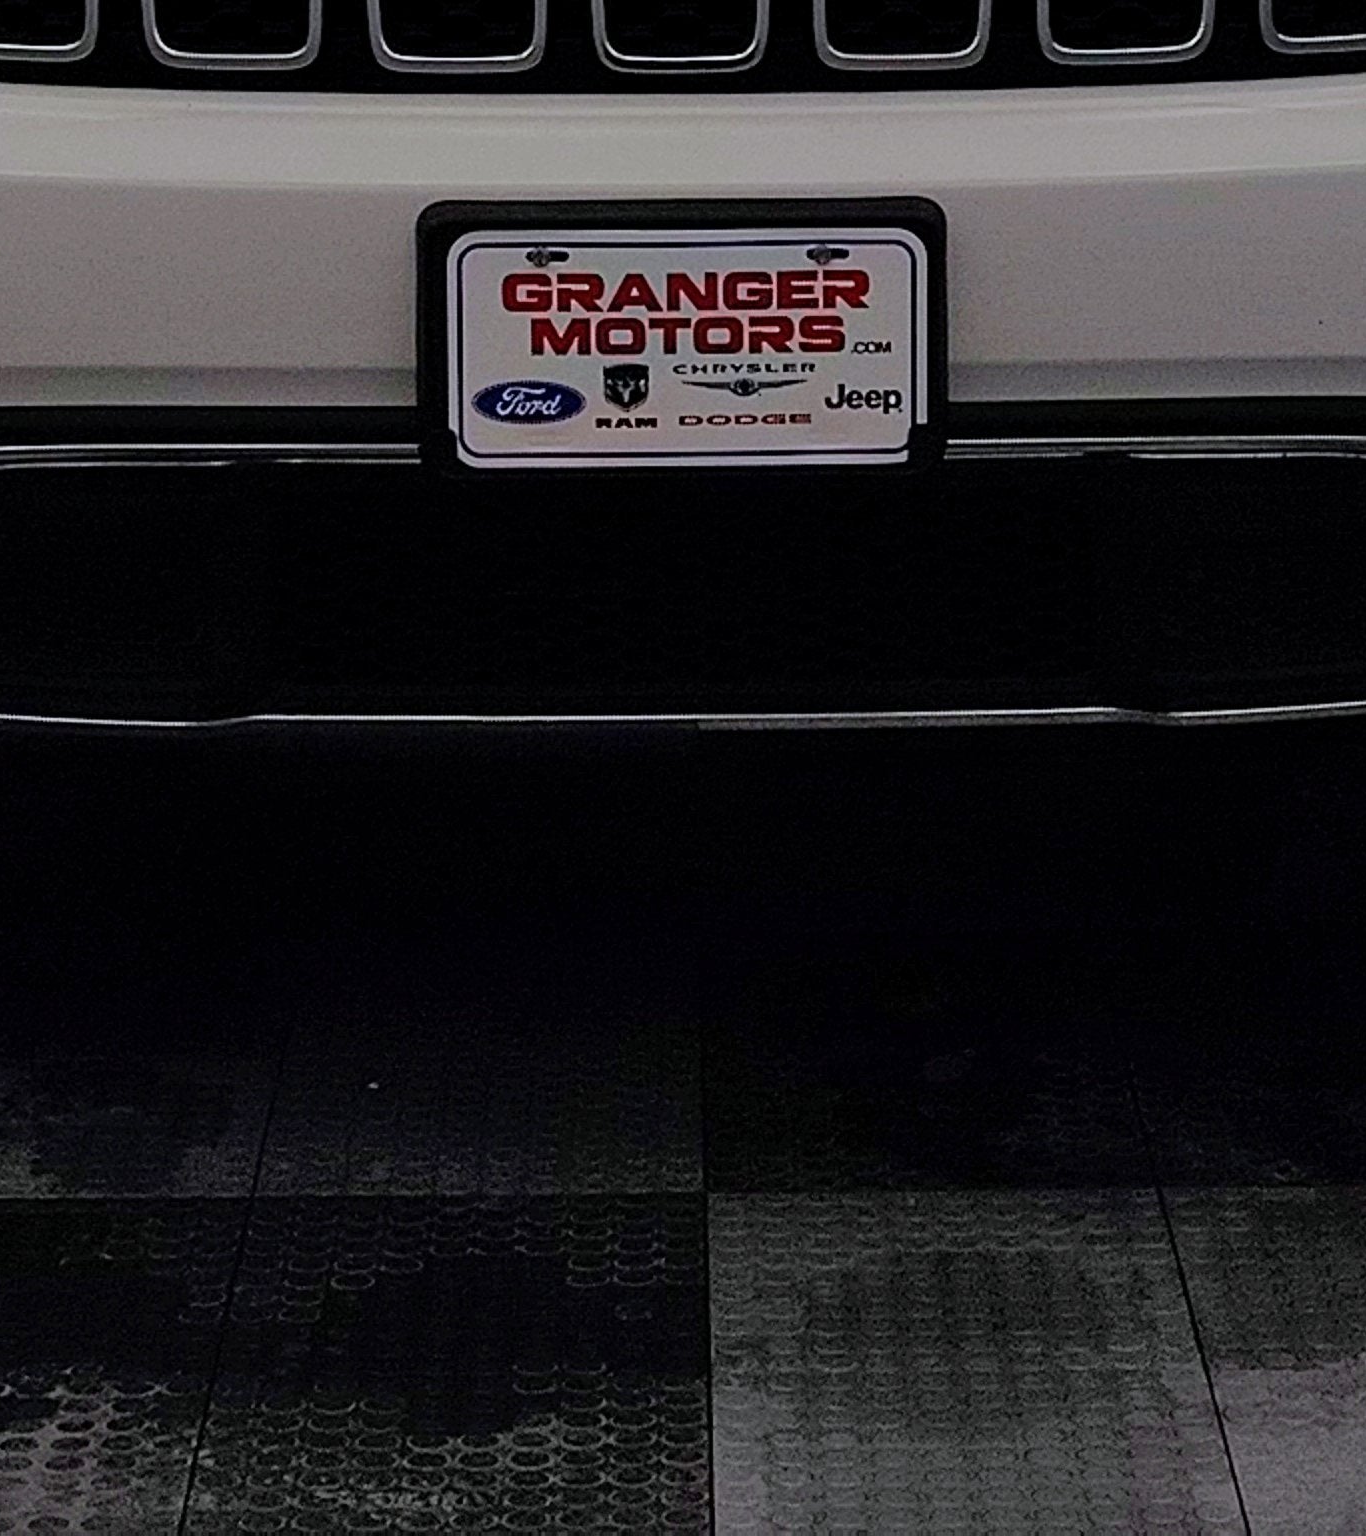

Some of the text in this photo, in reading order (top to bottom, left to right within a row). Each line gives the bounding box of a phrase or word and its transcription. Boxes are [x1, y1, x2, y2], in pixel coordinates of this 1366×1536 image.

[501, 268, 871, 313] GRANGER
[530, 314, 846, 356] MOTORS
[672, 362, 816, 374] CHRYSLER
[495, 386, 562, 417] Ford
[824, 383, 903, 414] Jeep
[595, 417, 658, 429] RAM
[678, 413, 812, 426] DODGE
